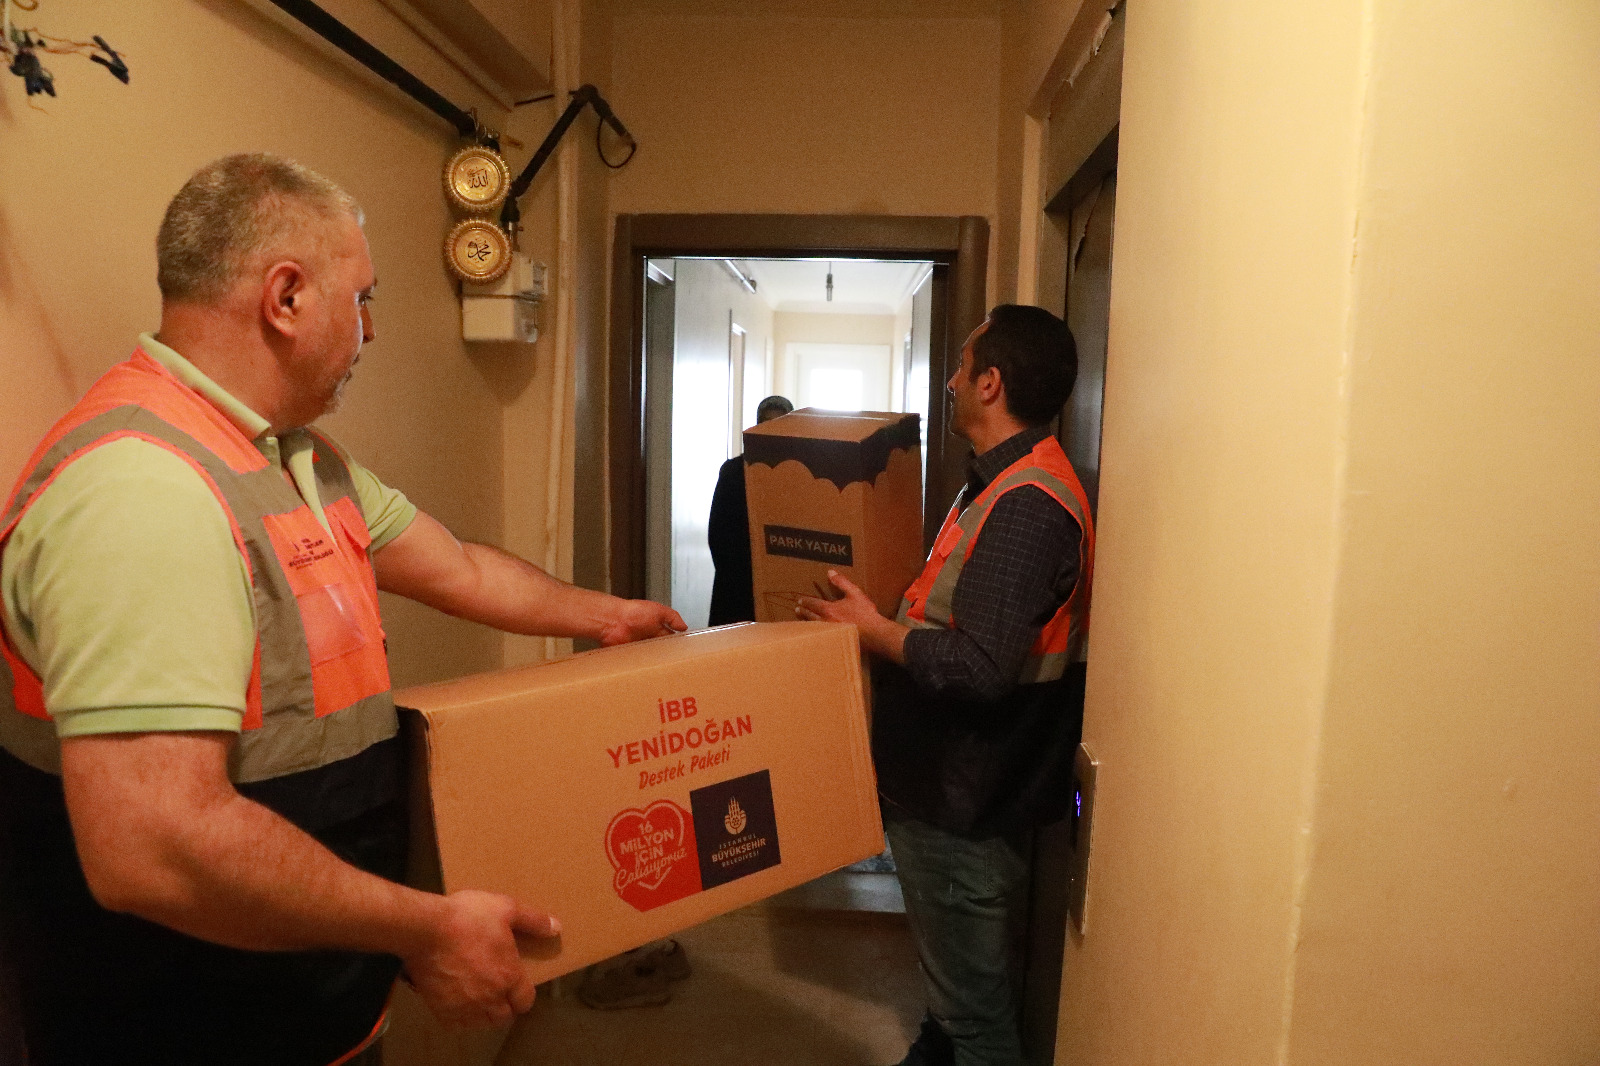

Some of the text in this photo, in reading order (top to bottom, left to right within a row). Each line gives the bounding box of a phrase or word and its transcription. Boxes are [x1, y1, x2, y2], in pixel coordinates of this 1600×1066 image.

[769, 535, 848, 556] PARK YATAK
[658, 697, 698, 724] İBB
[607, 715, 753, 769] YENİDOĞAN
[638, 744, 731, 789] Destek Paketi
[638, 821, 653, 835] 16
